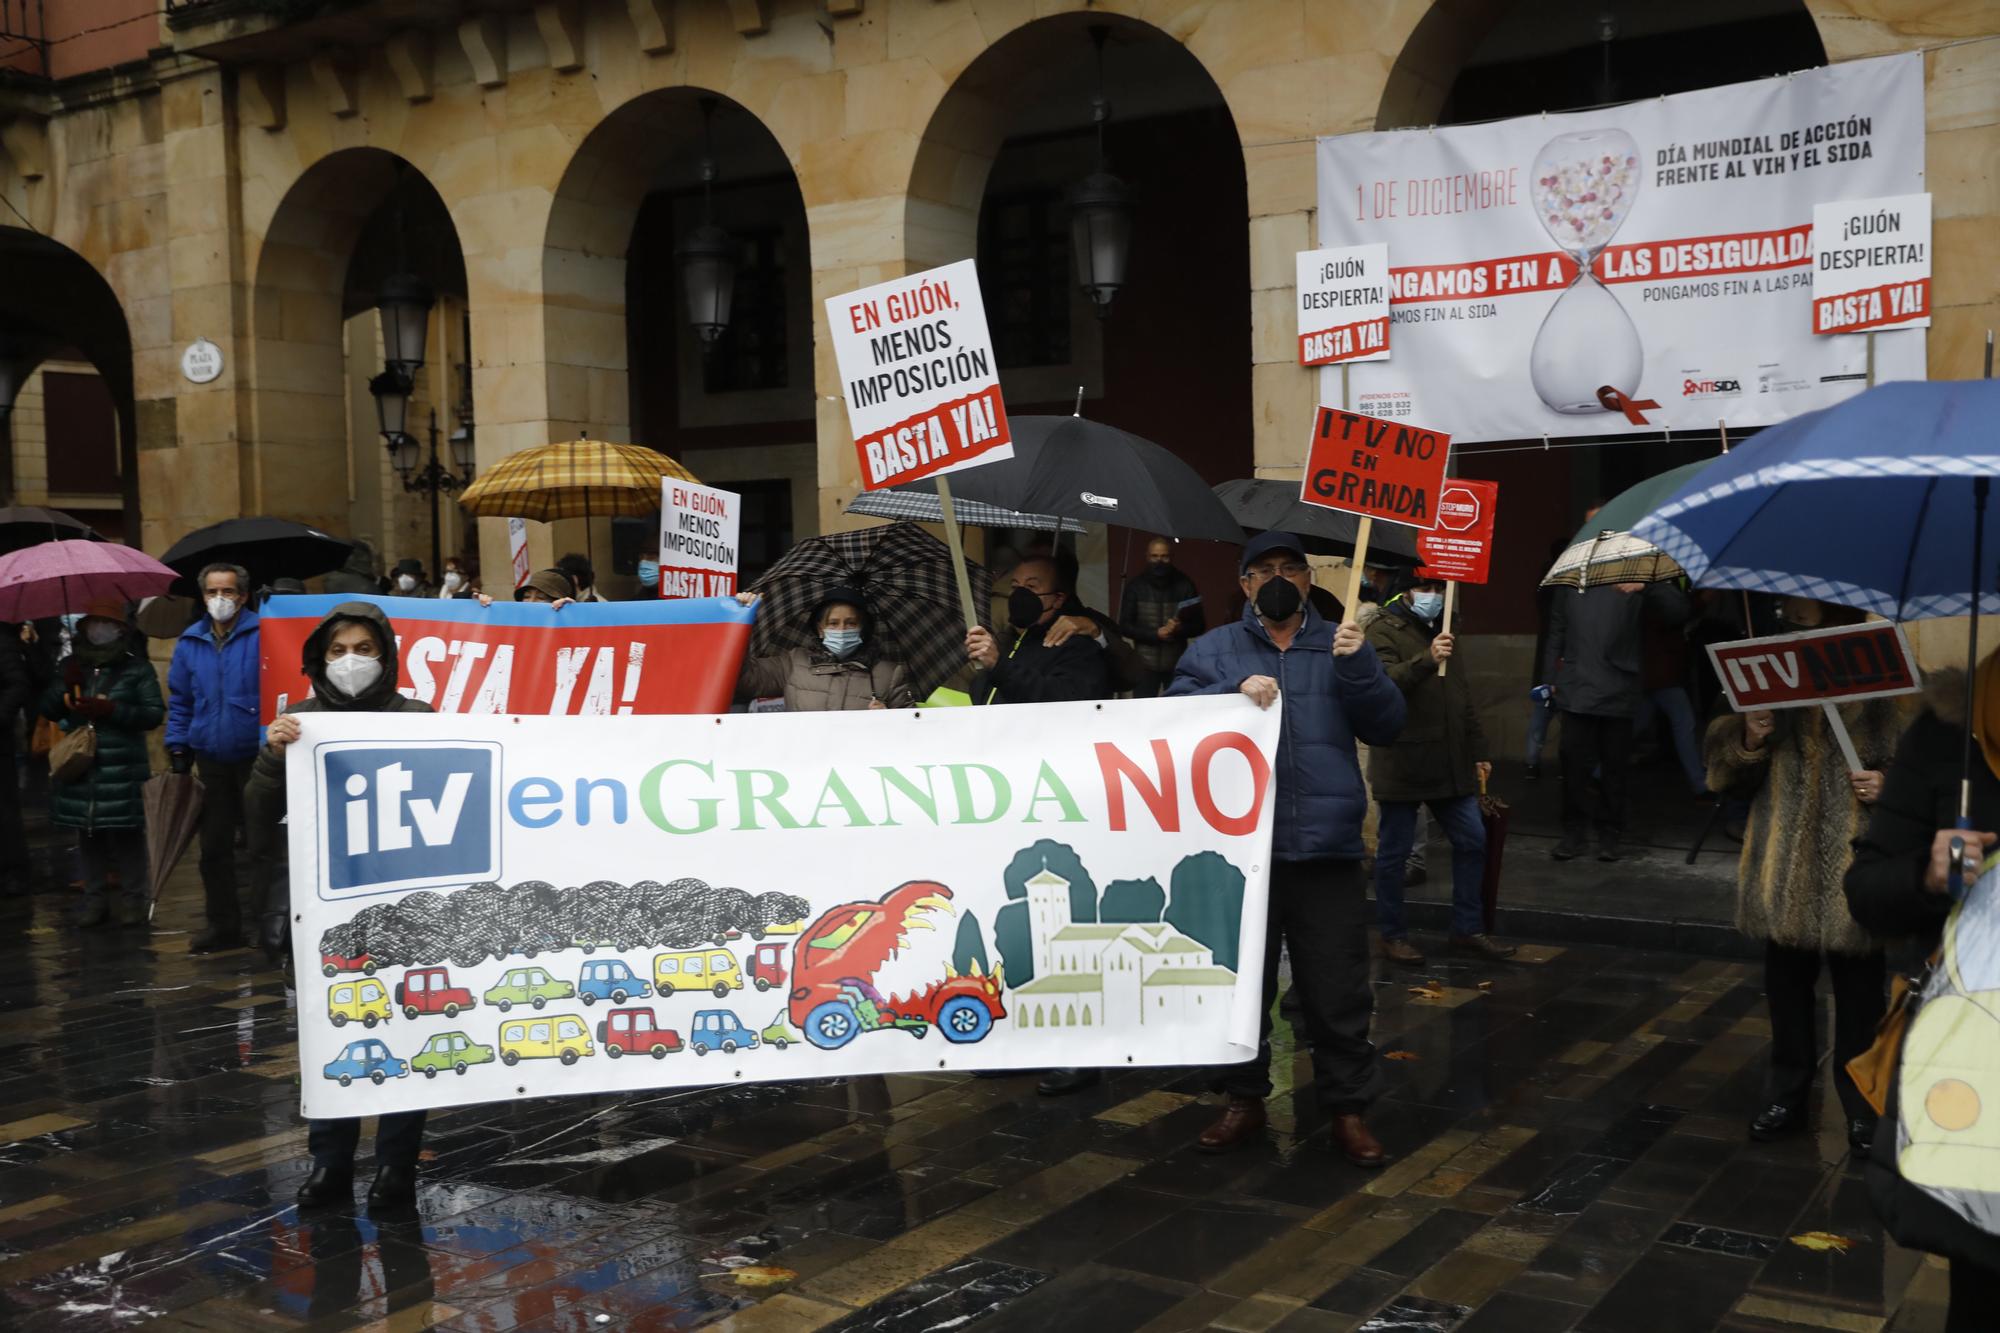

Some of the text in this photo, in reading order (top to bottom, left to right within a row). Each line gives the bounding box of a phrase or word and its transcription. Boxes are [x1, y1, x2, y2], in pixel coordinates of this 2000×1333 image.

[1656, 114, 1873, 167] DÍA MUNDIAL DE ACCIÓN
[1656, 140, 1873, 187] FRENTE AL VIH Y EL SIDA
[1355, 167, 1519, 221] 1 DE DICIEMBRE
[1844, 208, 1901, 241] ¡GIJÓN
[1320, 256, 1365, 285] ¡GIJÓN
[1389, 265, 1488, 300] NGAMOS
[1495, 259, 1539, 291] FIN
[1547, 257, 1564, 284] A
[1603, 248, 1652, 280] LAS
[1819, 243, 1924, 271] DESPIERTA!
[849, 278, 959, 334] EN GIJÓN,
[1303, 286, 1383, 311] DESPIERTA!
[1643, 281, 1719, 302] PONGAMOS
[1724, 280, 1749, 296] FIN
[1753, 278, 1762, 293] A
[1766, 275, 1789, 292] LAS
[1819, 283, 1923, 331] BASTA YA!
[1390, 303, 1497, 324] AMOS FIN AL SIDA
[870, 319, 952, 366] MENOS
[1303, 321, 1384, 362] BASTA YA!
[850, 345, 990, 409] IMPOSICIÓN
[865, 395, 999, 484] BASTA YA!
[1321, 410, 1436, 460] ITV NO
[1351, 449, 1378, 471] EN
[673, 487, 728, 520] EN GIJÓN,
[1312, 468, 1427, 519] GRANDA
[663, 530, 734, 566] IMPOSICIÓN
[679, 512, 720, 539] MENOS
[663, 570, 705, 598] BASTA
[395, 635, 647, 715] STA YA!
[1724, 631, 1905, 693] ITV NO!
[344, 730, 1271, 857] itv en GRANDA NO
